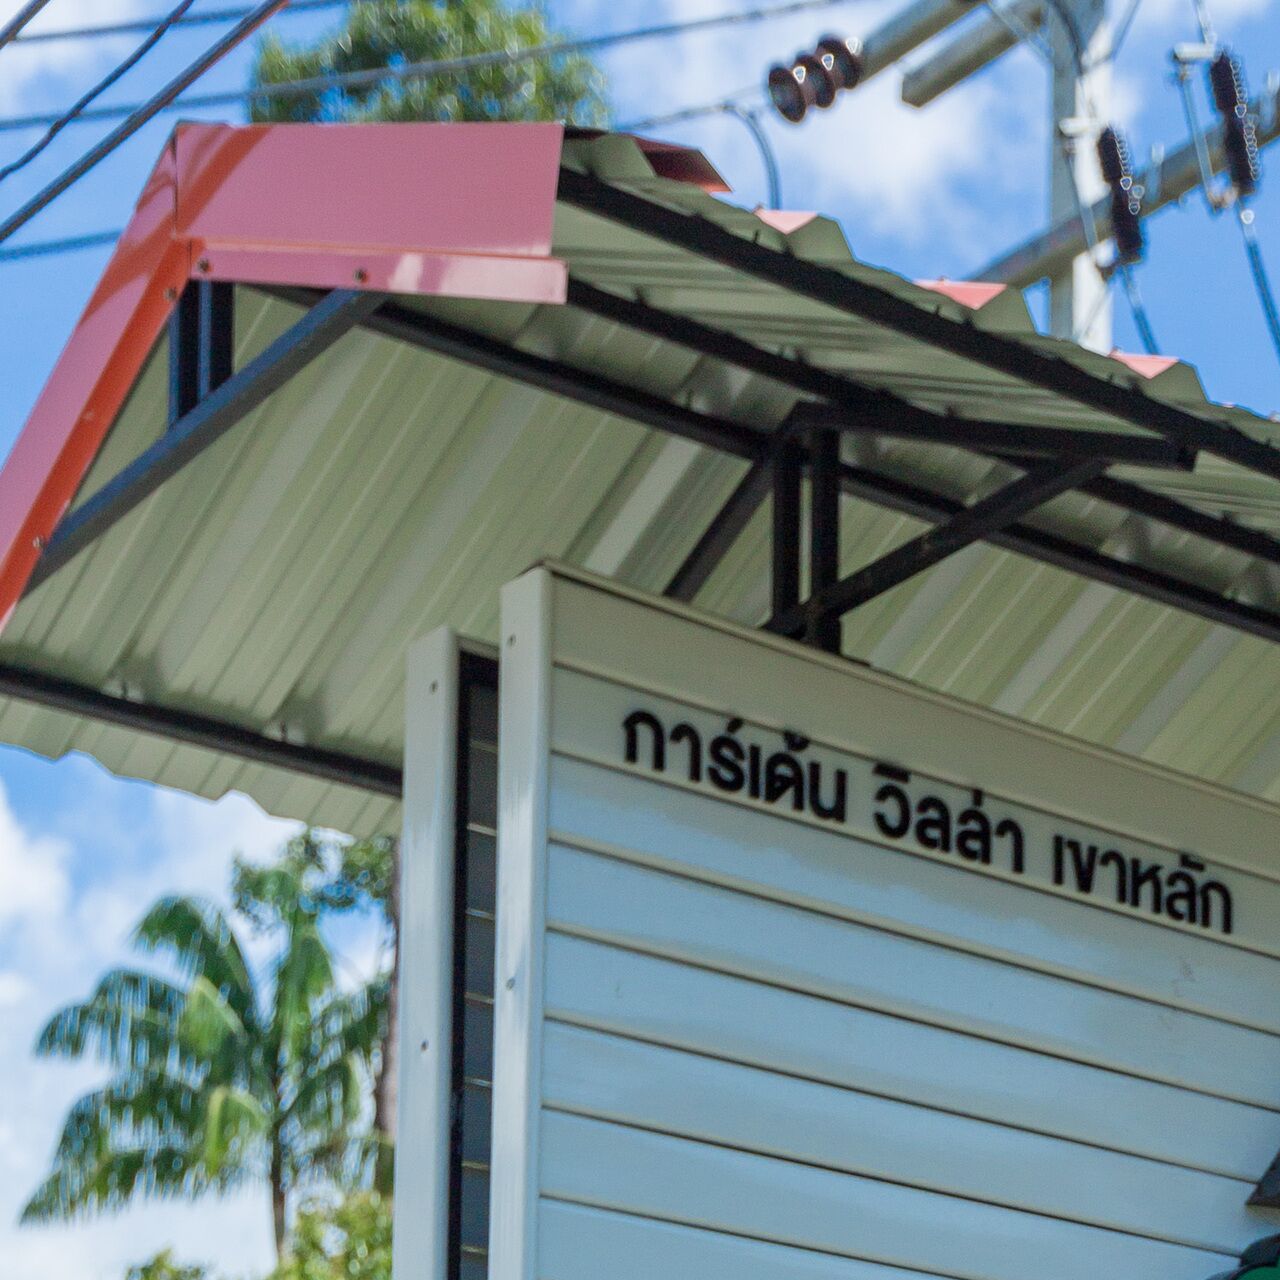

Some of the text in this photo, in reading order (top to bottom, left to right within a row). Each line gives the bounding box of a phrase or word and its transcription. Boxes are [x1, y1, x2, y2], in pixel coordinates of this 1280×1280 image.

[622, 709, 1234, 934] การ์เด้น วิลล่า เขาหลัก
